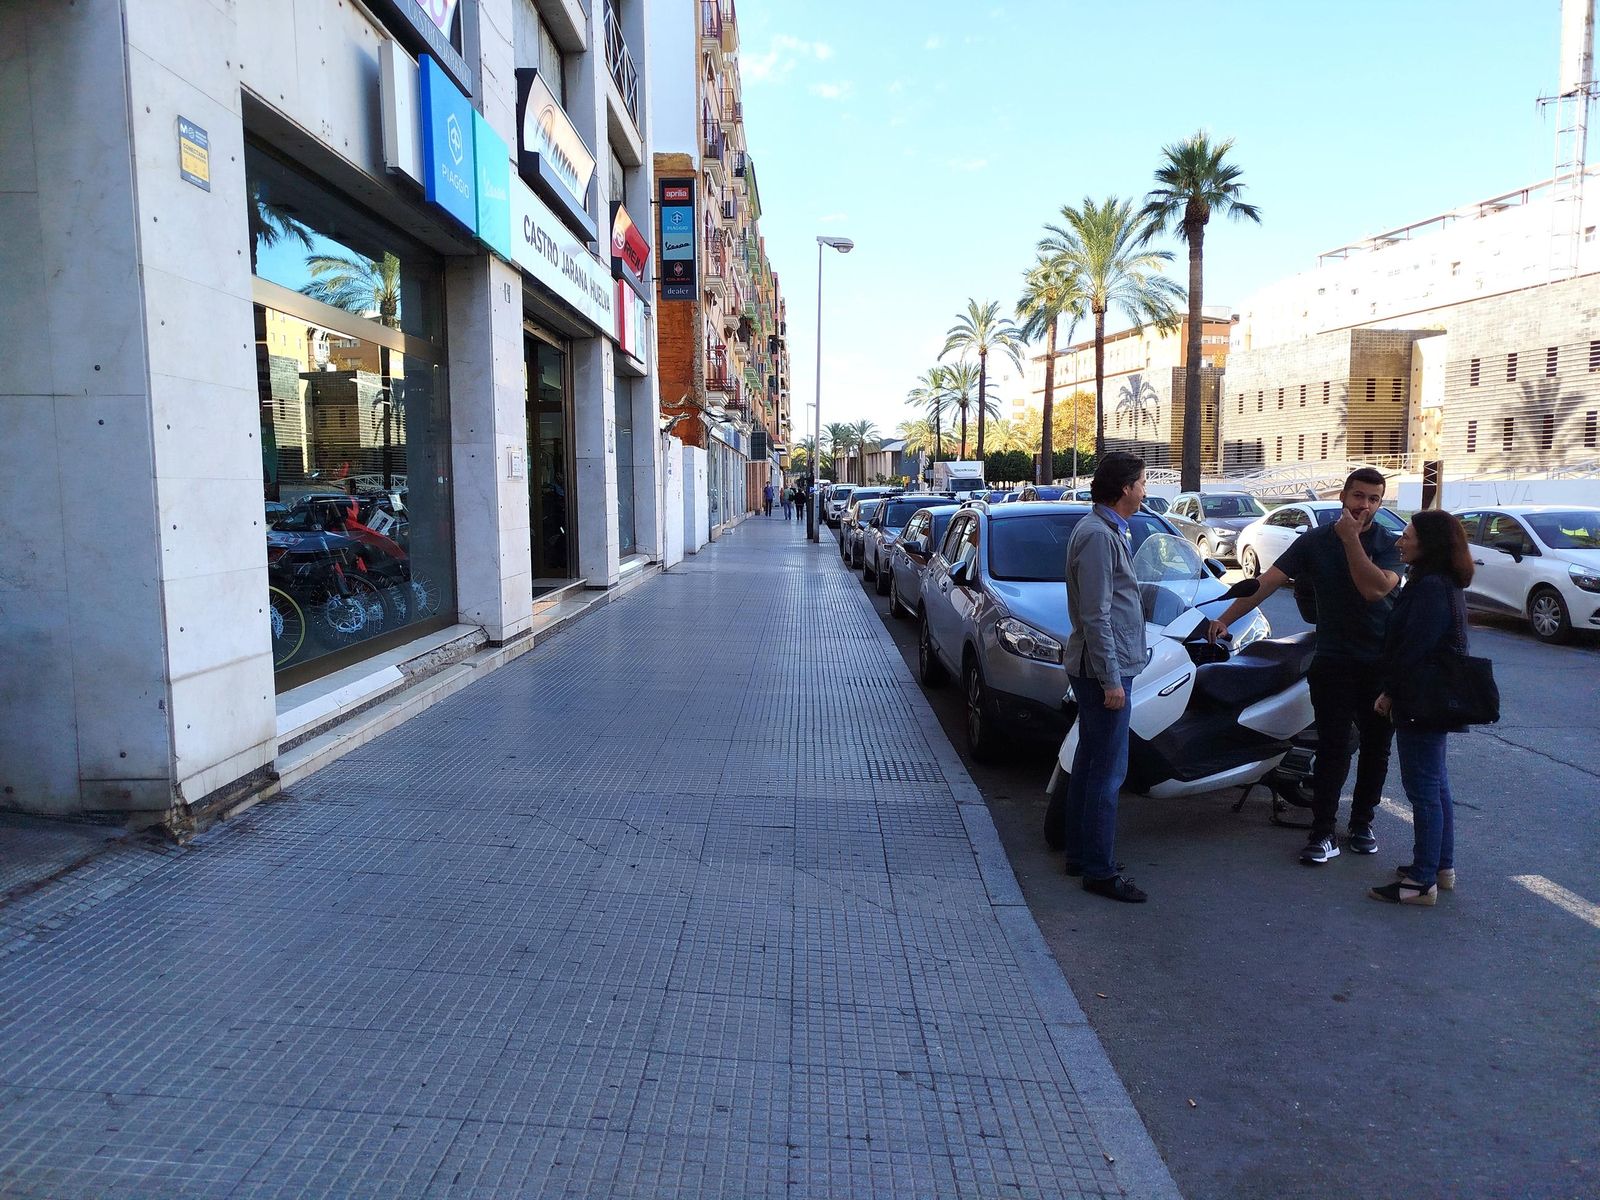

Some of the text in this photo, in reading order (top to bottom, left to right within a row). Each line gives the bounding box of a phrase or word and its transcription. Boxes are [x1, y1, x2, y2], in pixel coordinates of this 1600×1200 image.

[441, 163, 470, 199] PIAGGIO
[665, 188, 688, 199] aprilia
[523, 214, 611, 315] CASTRO JARANA HUELVA
[667, 287, 689, 295] dealer
